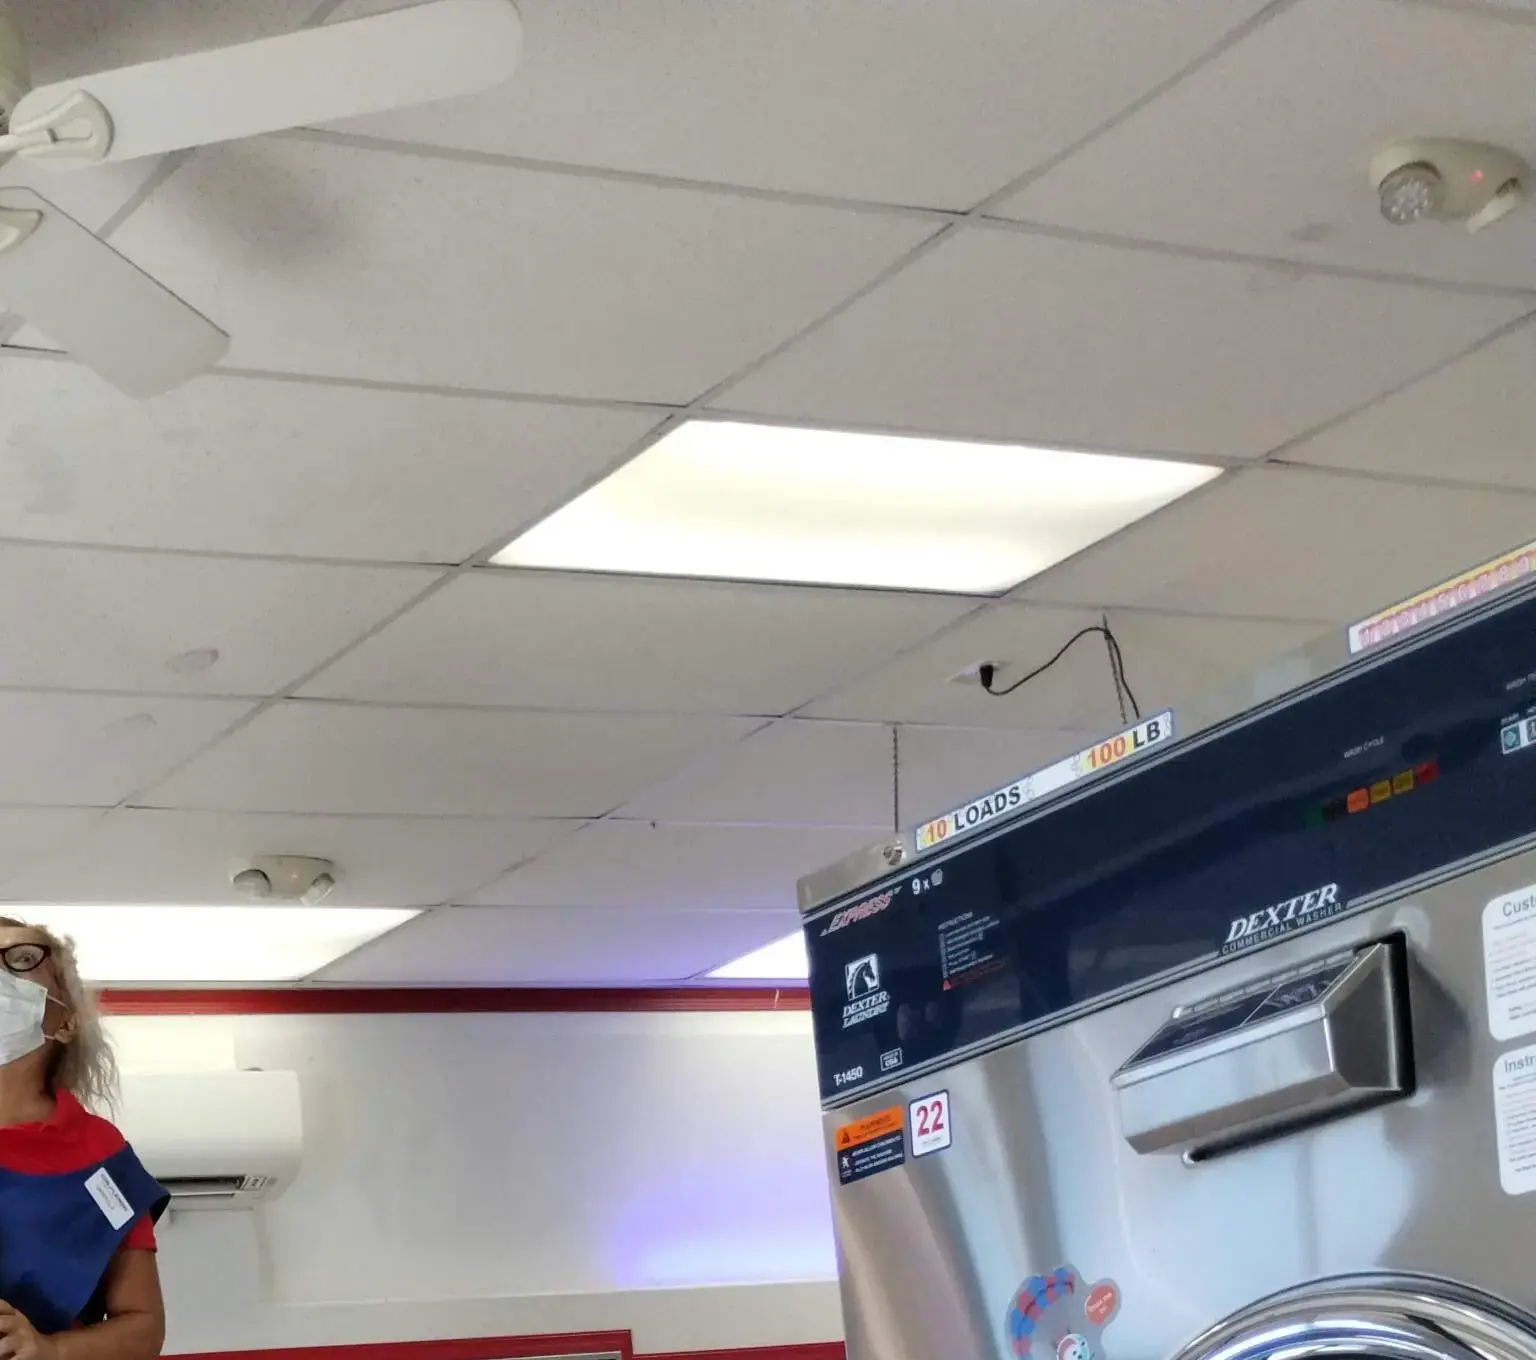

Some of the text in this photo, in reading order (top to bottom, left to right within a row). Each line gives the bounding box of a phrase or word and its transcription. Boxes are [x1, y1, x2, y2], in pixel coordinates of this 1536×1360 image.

[1344, 736, 1385, 758] WASH CYCLE
[927, 720, 1161, 843] 10 LOADS 100 LB
[912, 878, 921, 895] 9
[1224, 882, 1338, 943] DEXTER
[1502, 894, 1536, 917] Cust
[1222, 902, 1343, 955] COMMERCIAL WASHER
[842, 991, 889, 1018] DEXTER
[842, 1001, 890, 1029] LAUNDRY
[833, 1066, 864, 1087] T-1450
[917, 1100, 944, 1137] 22
